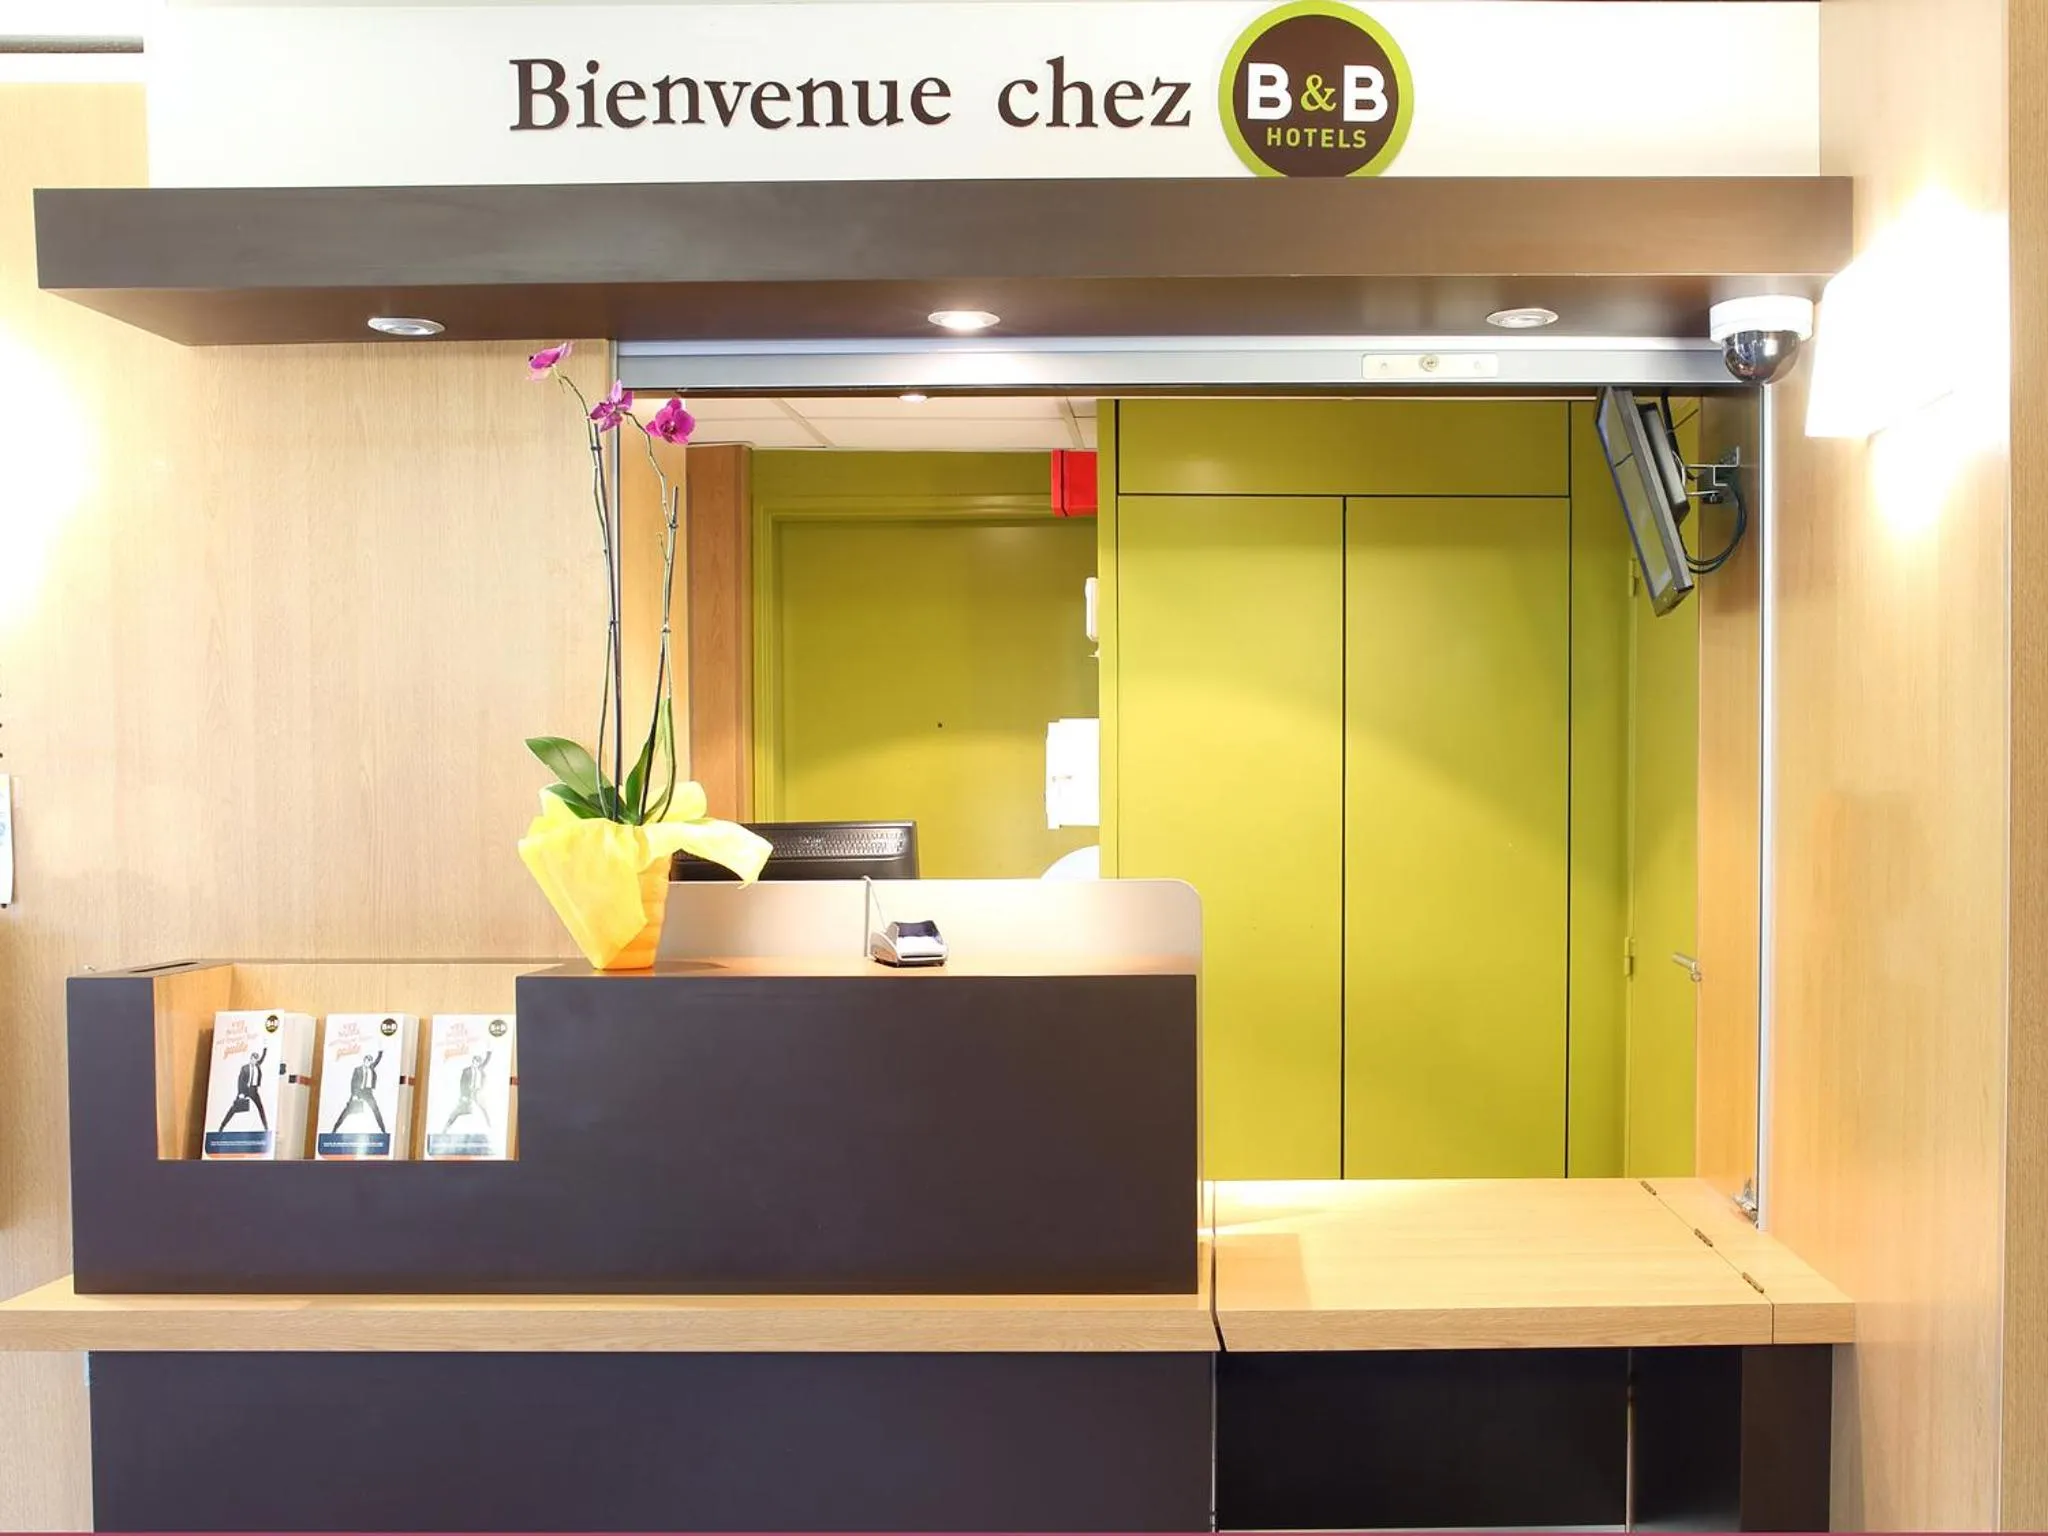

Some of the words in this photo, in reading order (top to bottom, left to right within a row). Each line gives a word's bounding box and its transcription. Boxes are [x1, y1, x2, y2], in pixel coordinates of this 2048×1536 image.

[509, 58, 951, 131] Bienvenue
[997, 55, 1191, 128] chez
[1266, 127, 1367, 150] HOTELS
